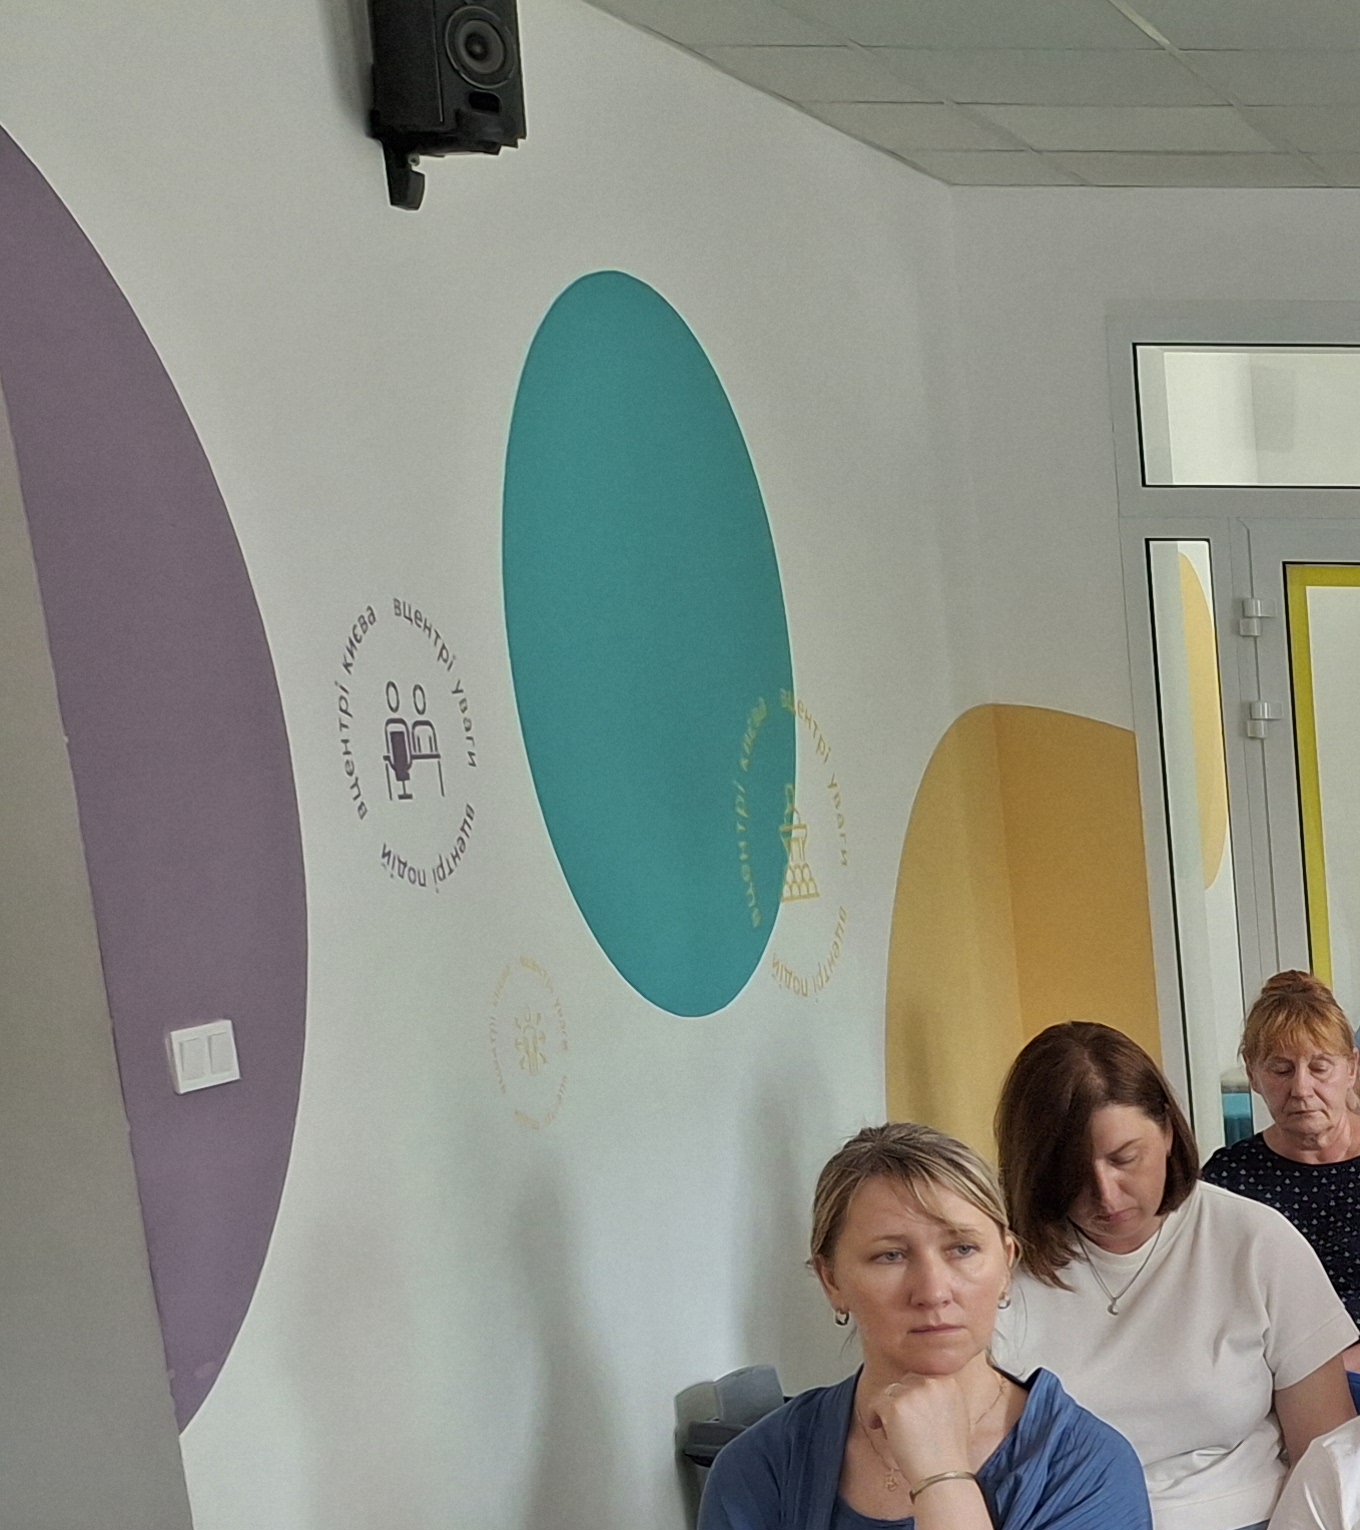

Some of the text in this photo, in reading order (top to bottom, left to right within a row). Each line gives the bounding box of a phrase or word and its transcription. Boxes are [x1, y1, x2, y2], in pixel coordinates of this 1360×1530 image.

[334, 605, 377, 820] вцентрі києва
[392, 598, 477, 768] вцентрі уваги
[381, 803, 475, 893] вцентрі подій
